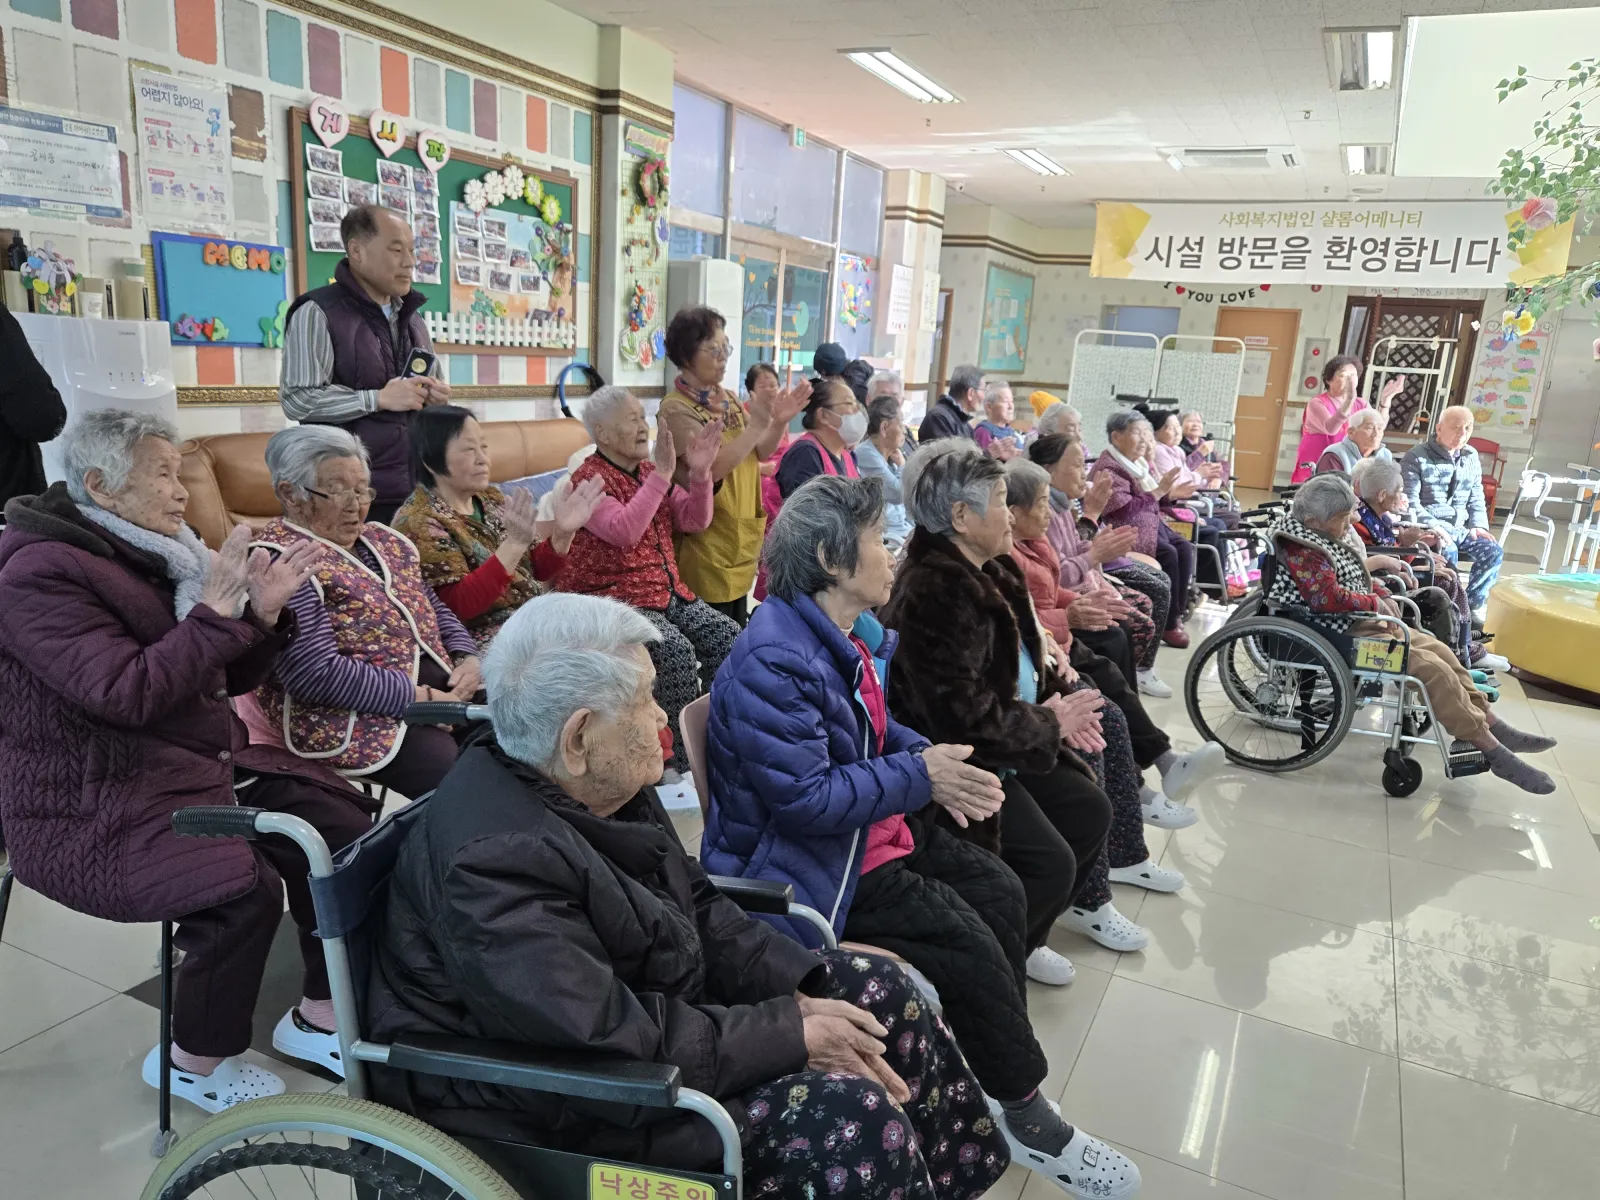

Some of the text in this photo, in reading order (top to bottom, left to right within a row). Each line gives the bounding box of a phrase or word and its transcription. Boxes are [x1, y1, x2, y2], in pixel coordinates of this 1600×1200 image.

[141, 87, 204, 112] 어렵지 않아요!
[1218, 210, 1423, 229] 사회복지법인 샬롬어메니티
[204, 242, 286, 274] MEMO
[1144, 235, 1502, 274] 시설 방문을 환영합니다
[1188, 289, 1213, 303] YOU
[1220, 287, 1255, 304] LOVE
